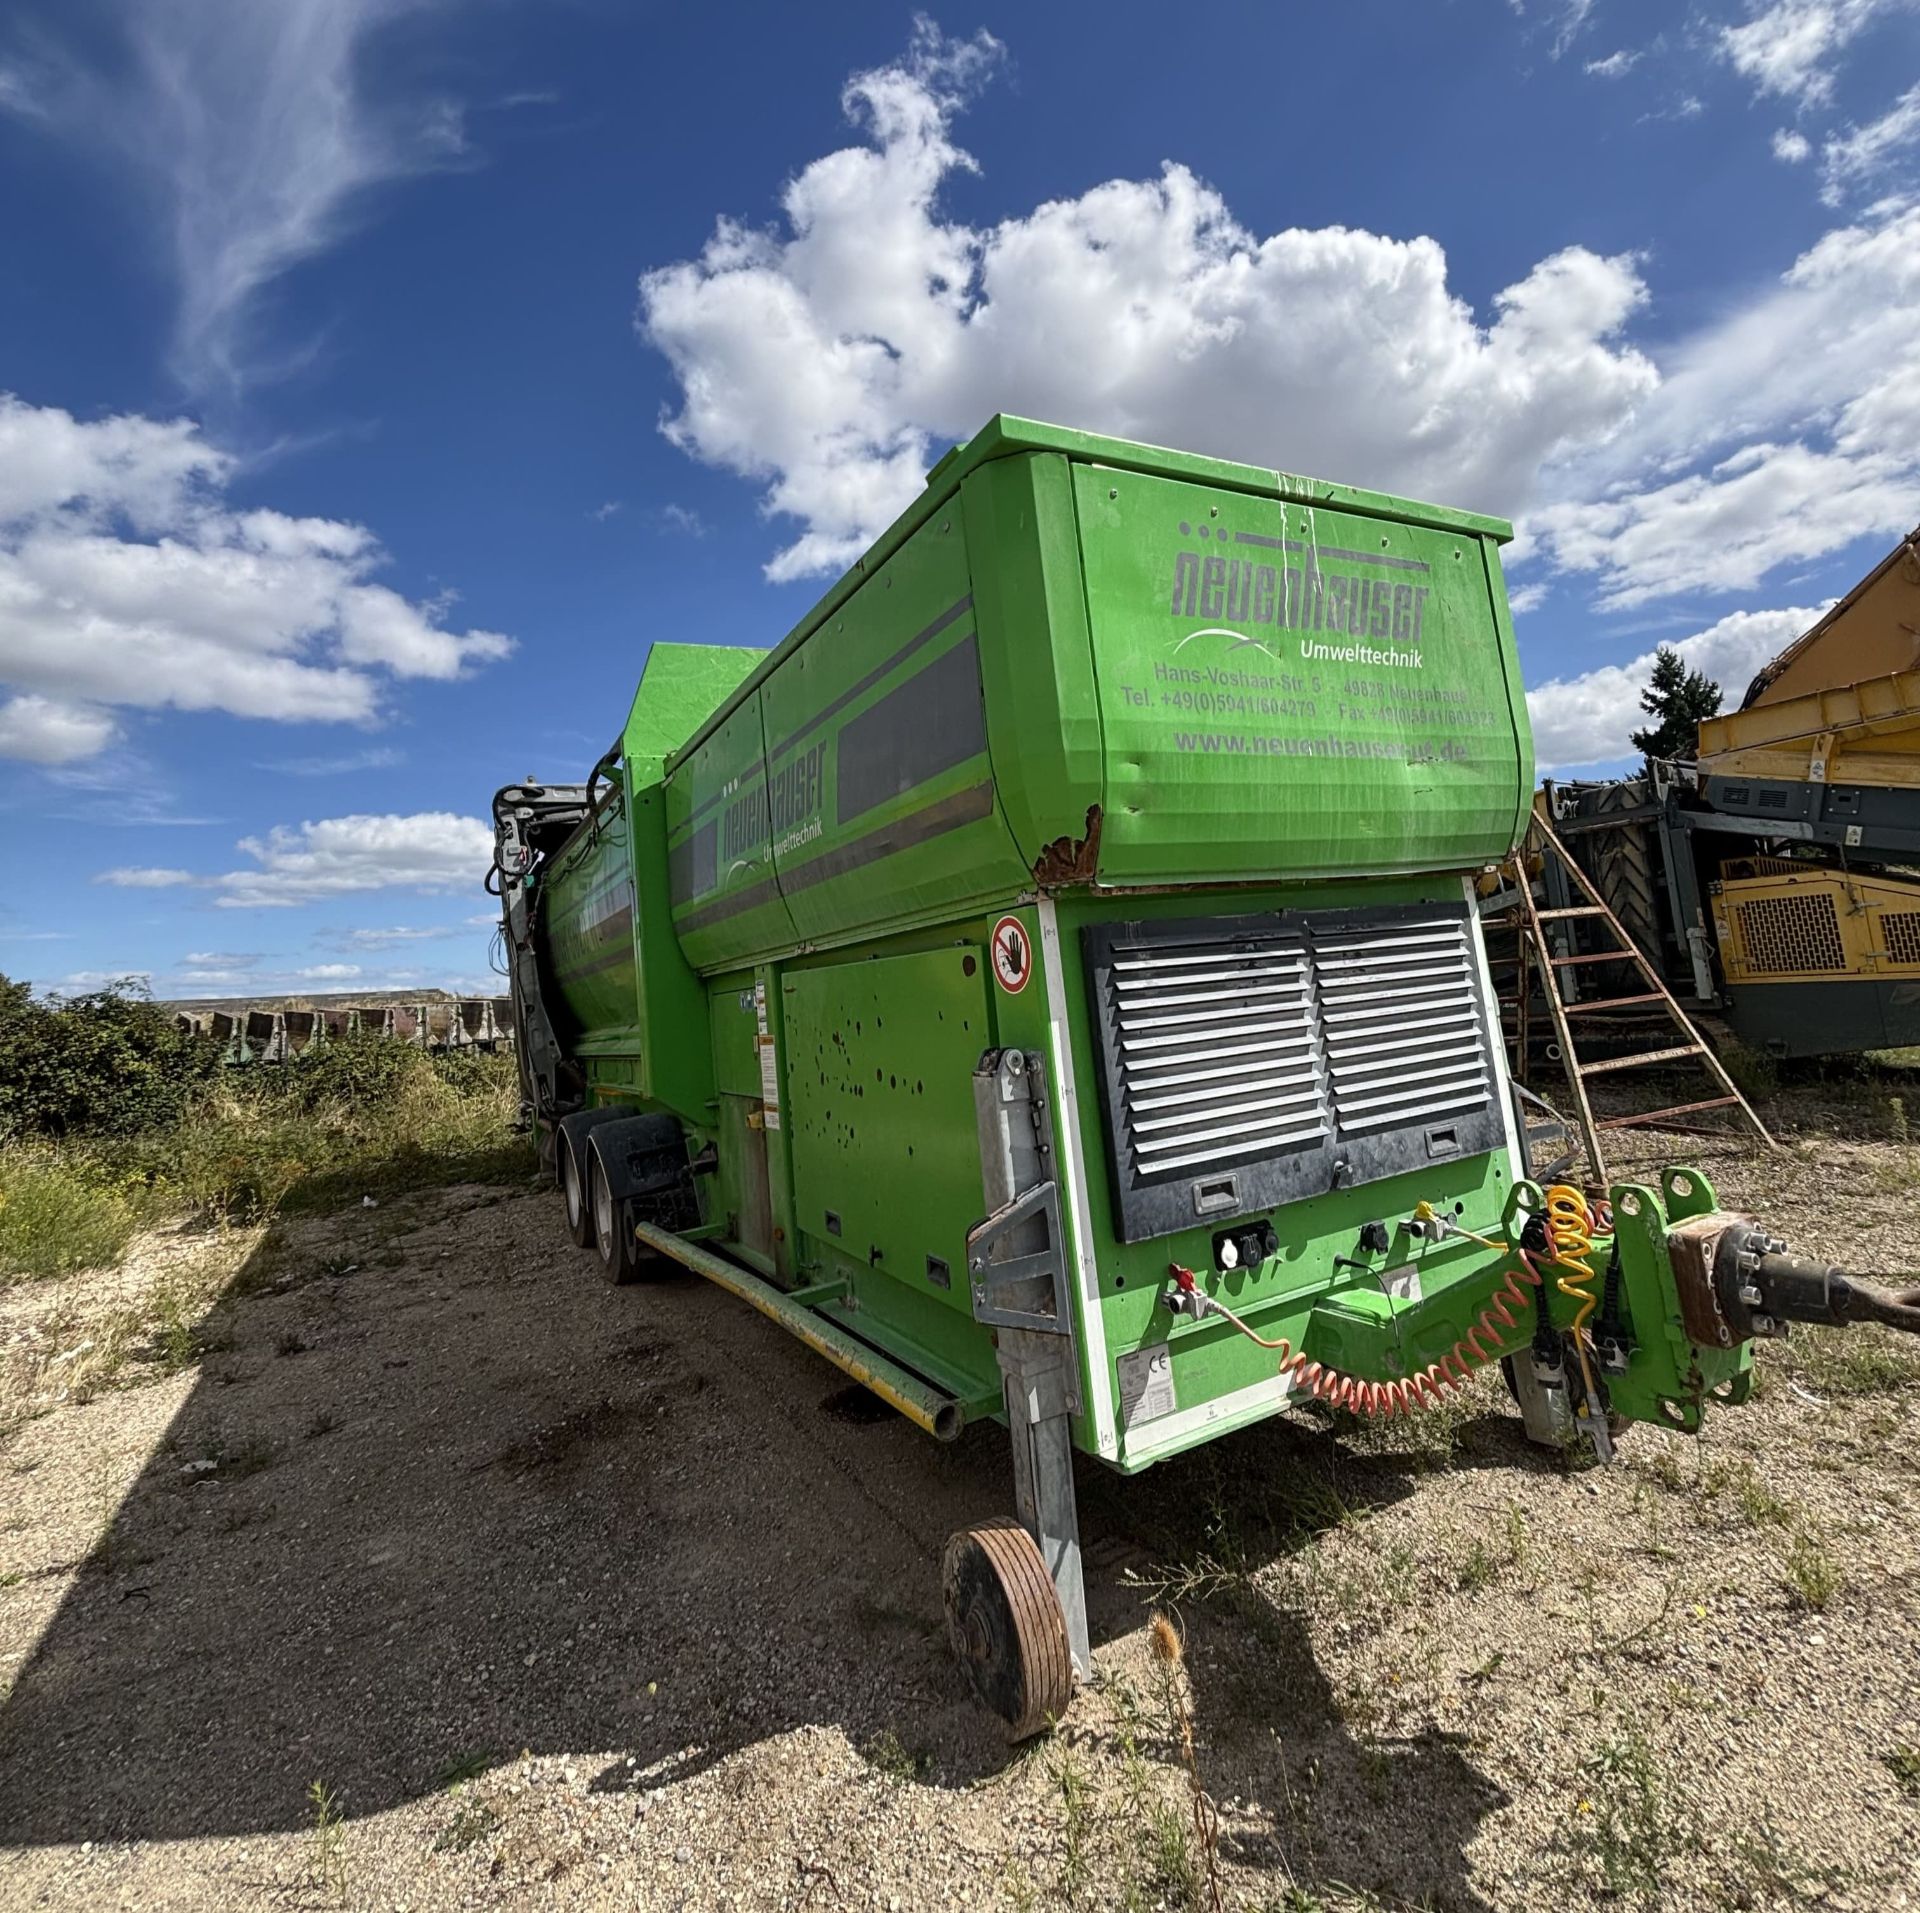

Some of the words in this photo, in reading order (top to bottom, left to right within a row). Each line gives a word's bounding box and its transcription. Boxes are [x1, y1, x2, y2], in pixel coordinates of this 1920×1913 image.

[1301, 639, 1423, 669] Umwelttechnik
[1120, 686, 1155, 707] Tel.
[763, 816, 822, 862] Umwelttechnik
[1149, 1352, 1167, 1373] CE
